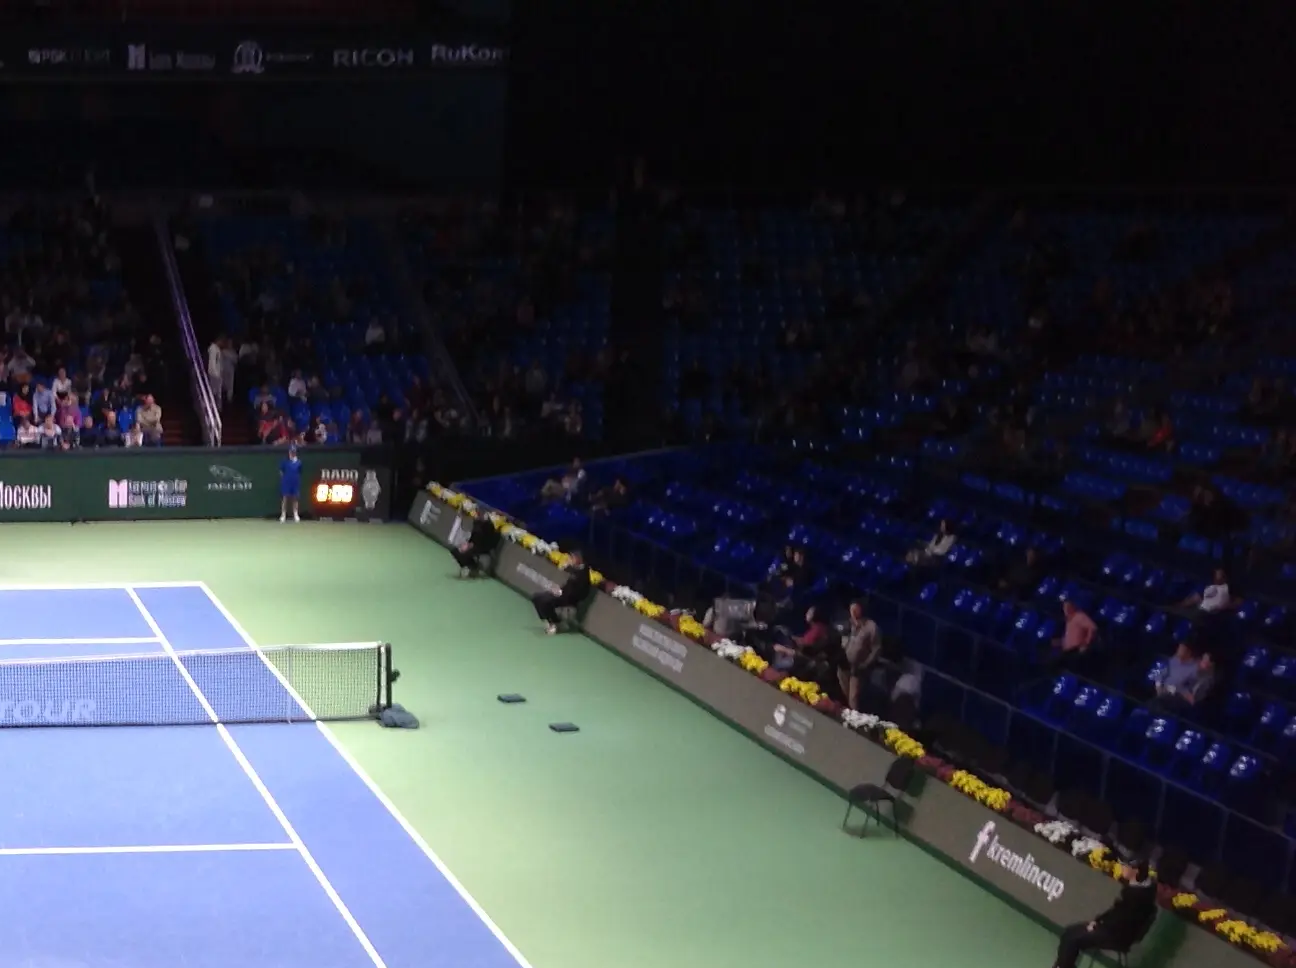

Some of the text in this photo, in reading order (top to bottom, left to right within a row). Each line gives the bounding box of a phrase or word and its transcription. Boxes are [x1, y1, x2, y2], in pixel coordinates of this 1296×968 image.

[332, 48, 414, 67] RICOH
[321, 469, 359, 482] RADO
[986, 834, 1065, 902] kremlincup
